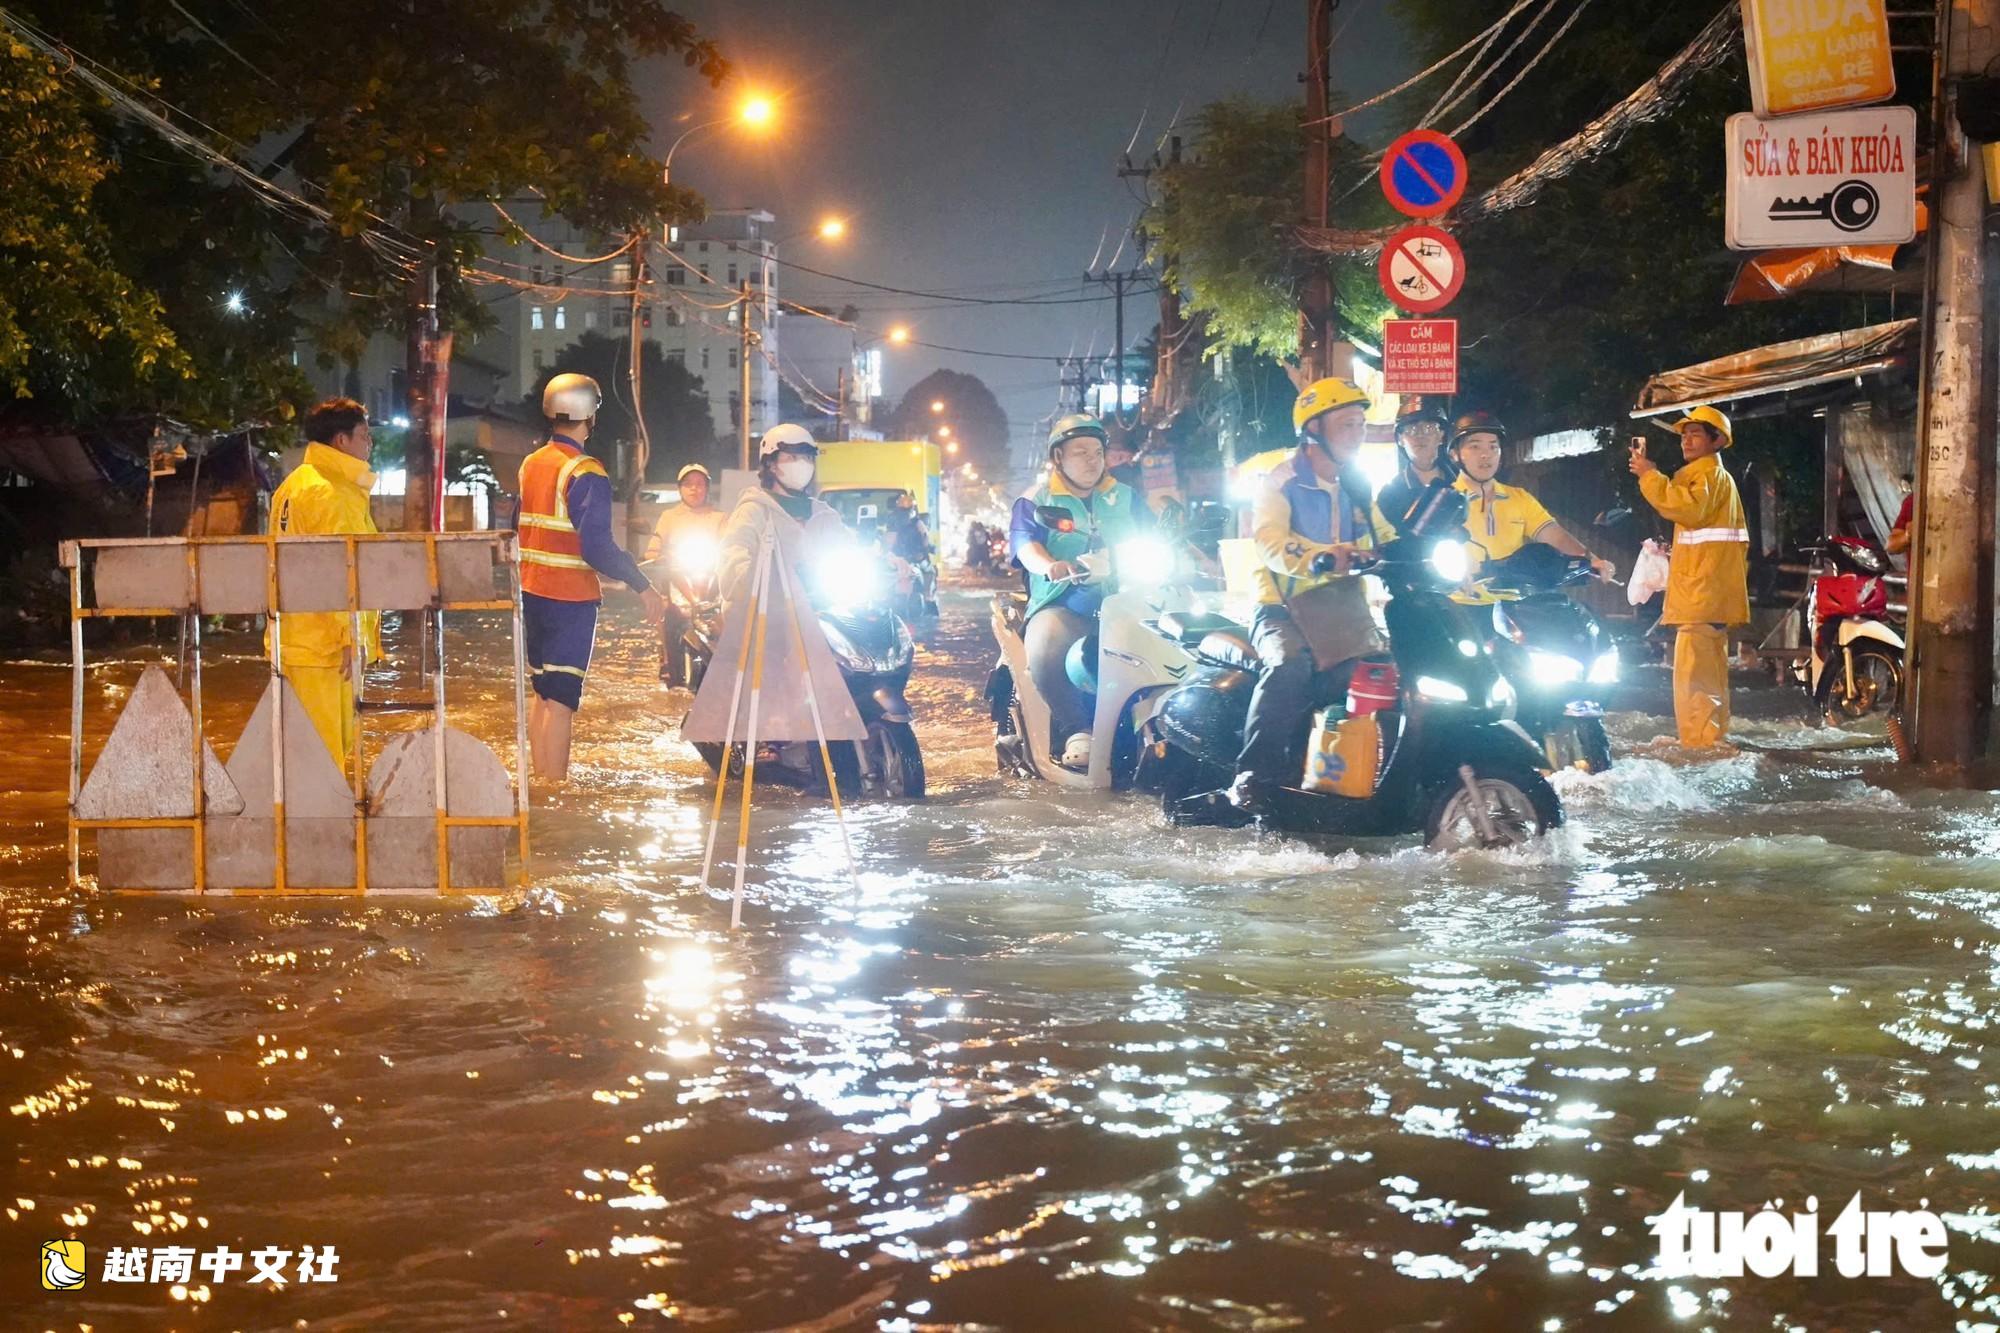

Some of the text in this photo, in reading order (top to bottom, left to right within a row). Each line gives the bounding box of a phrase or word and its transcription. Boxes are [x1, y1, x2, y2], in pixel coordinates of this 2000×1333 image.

[1744, 123, 1905, 177] SỬA & BÁN KHÓA
[1432, 340, 1451, 354] BÁNH
